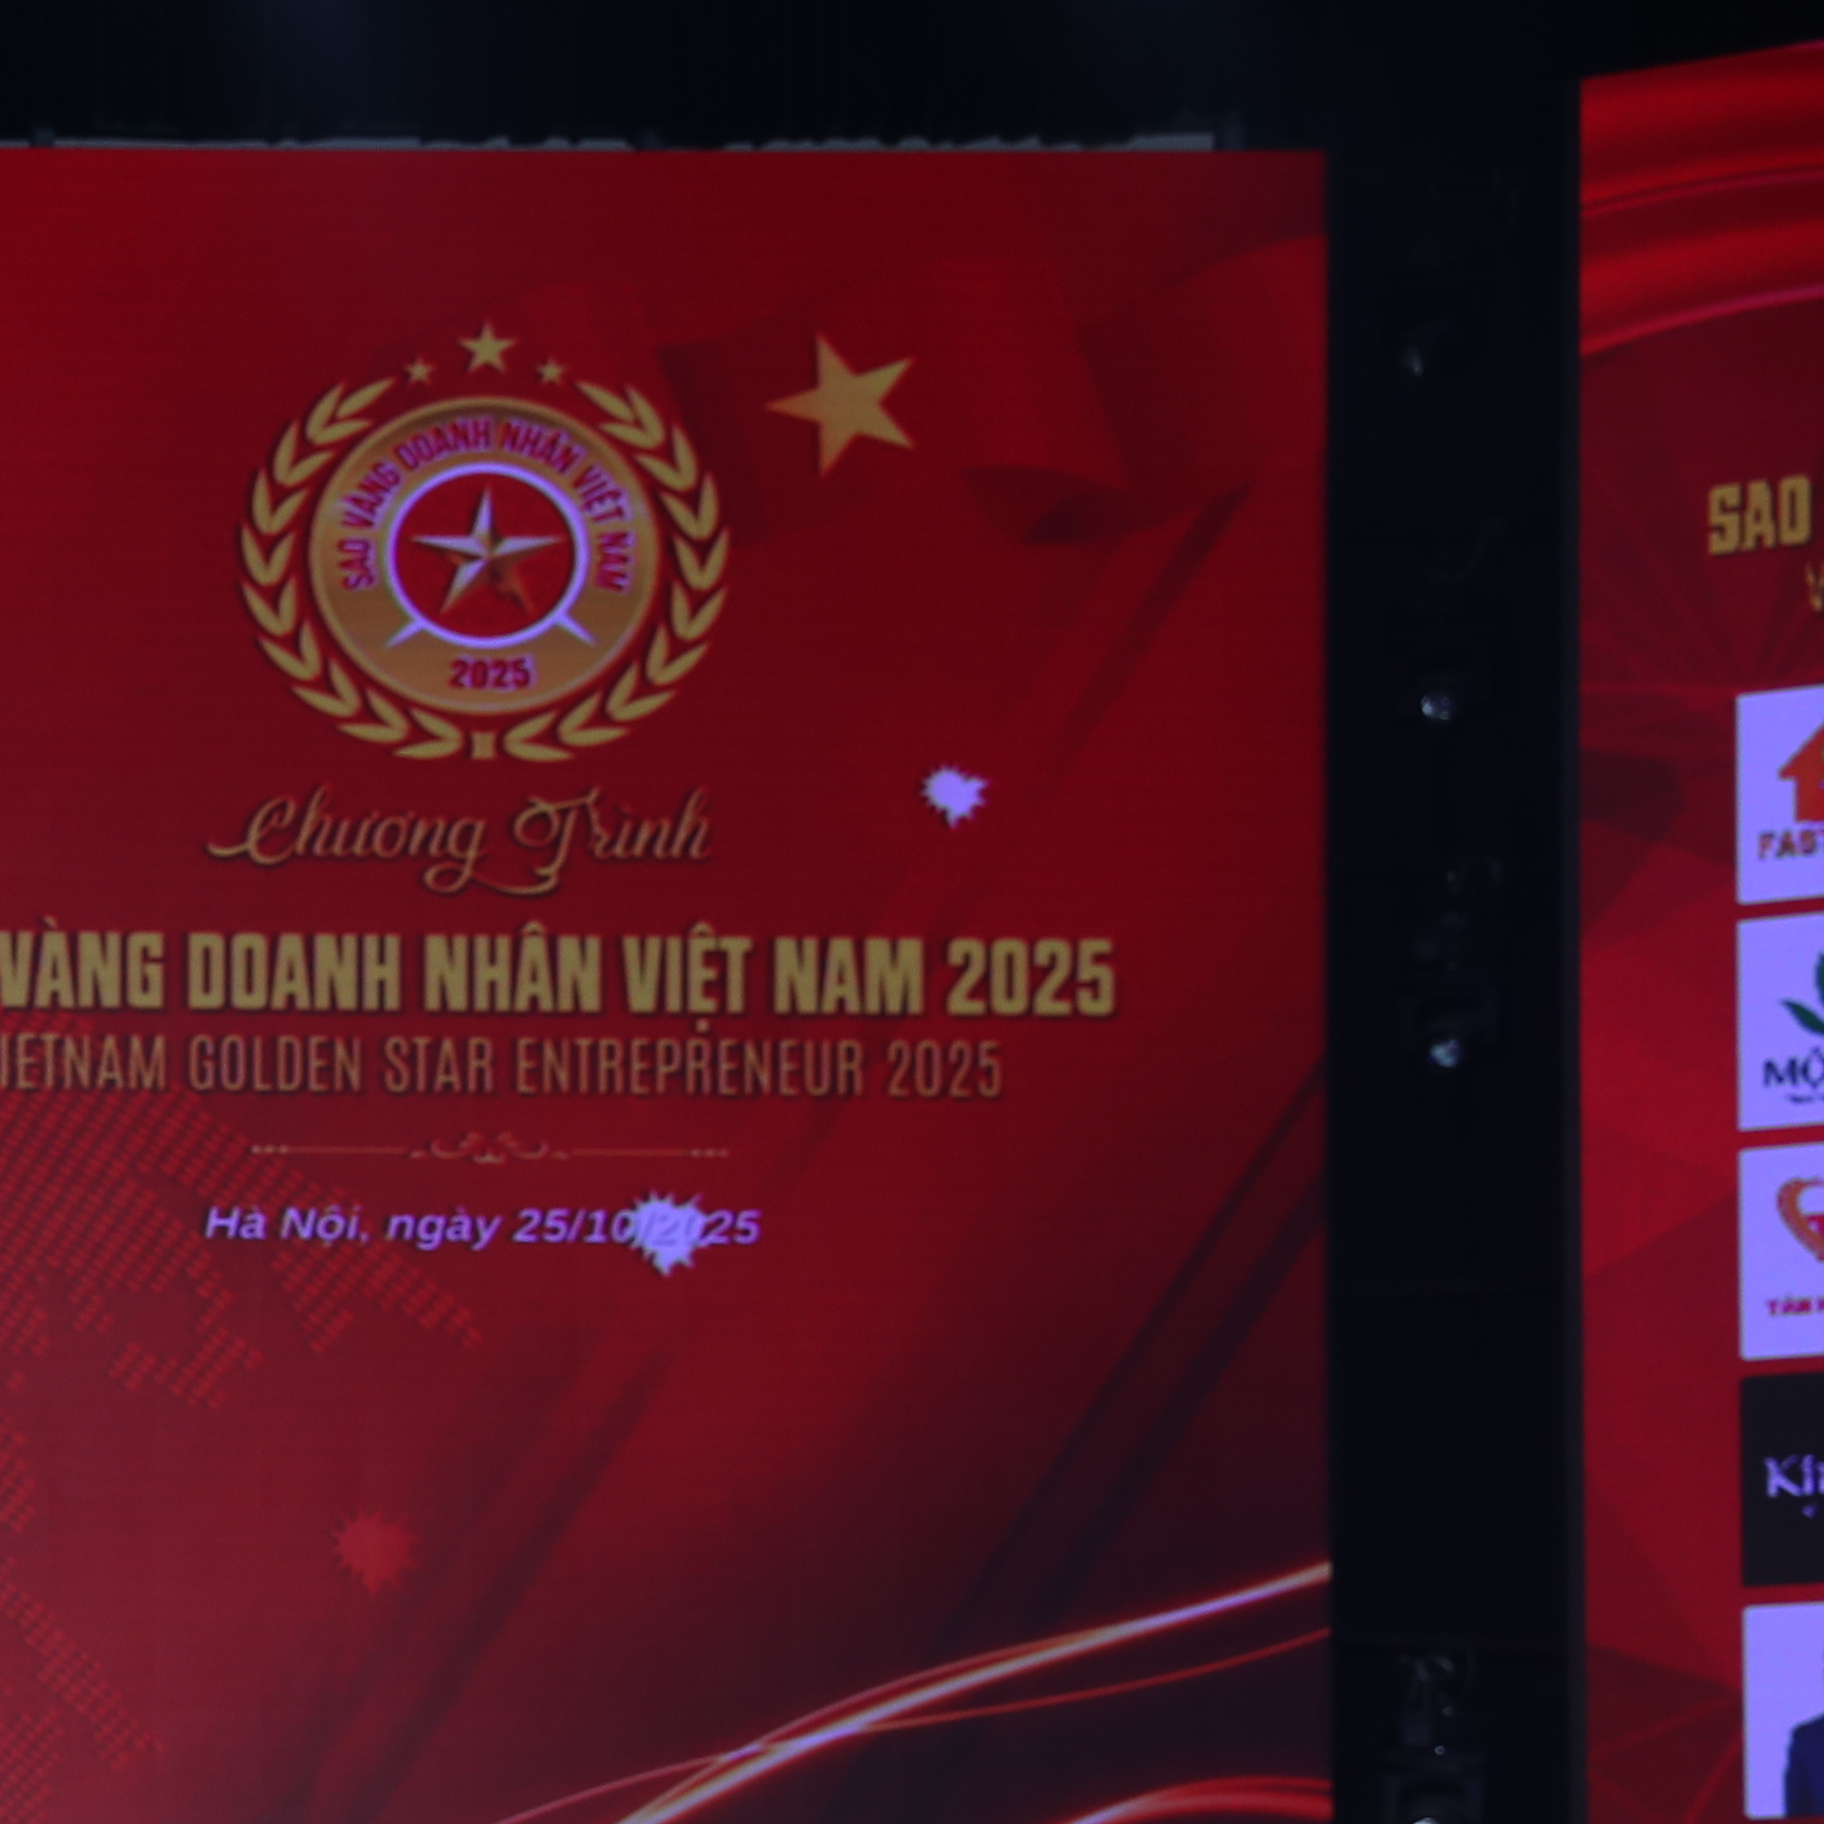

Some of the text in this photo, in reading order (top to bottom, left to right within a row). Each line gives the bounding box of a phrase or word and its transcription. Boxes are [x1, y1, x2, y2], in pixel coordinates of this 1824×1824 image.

[1708, 474, 1811, 556] SAO
[449, 654, 536, 692] 2025
[208, 787, 709, 894] Chương Trình
[189, 933, 400, 1010] DOANH
[425, 921, 600, 1012] NHÂN
[623, 922, 751, 1031] VIỆT
[775, 937, 923, 1014] NAM
[948, 938, 1113, 1015] 2025
[190, 1034, 360, 1091] GOLDEN
[385, 1036, 492, 1092] STAR
[517, 1037, 861, 1095] ENTREPRENEUR
[888, 1040, 1000, 1097] 2025
[207, 1206, 266, 1240] Hà
[281, 1205, 370, 1246] Nội,
[388, 1209, 502, 1251] ngày
